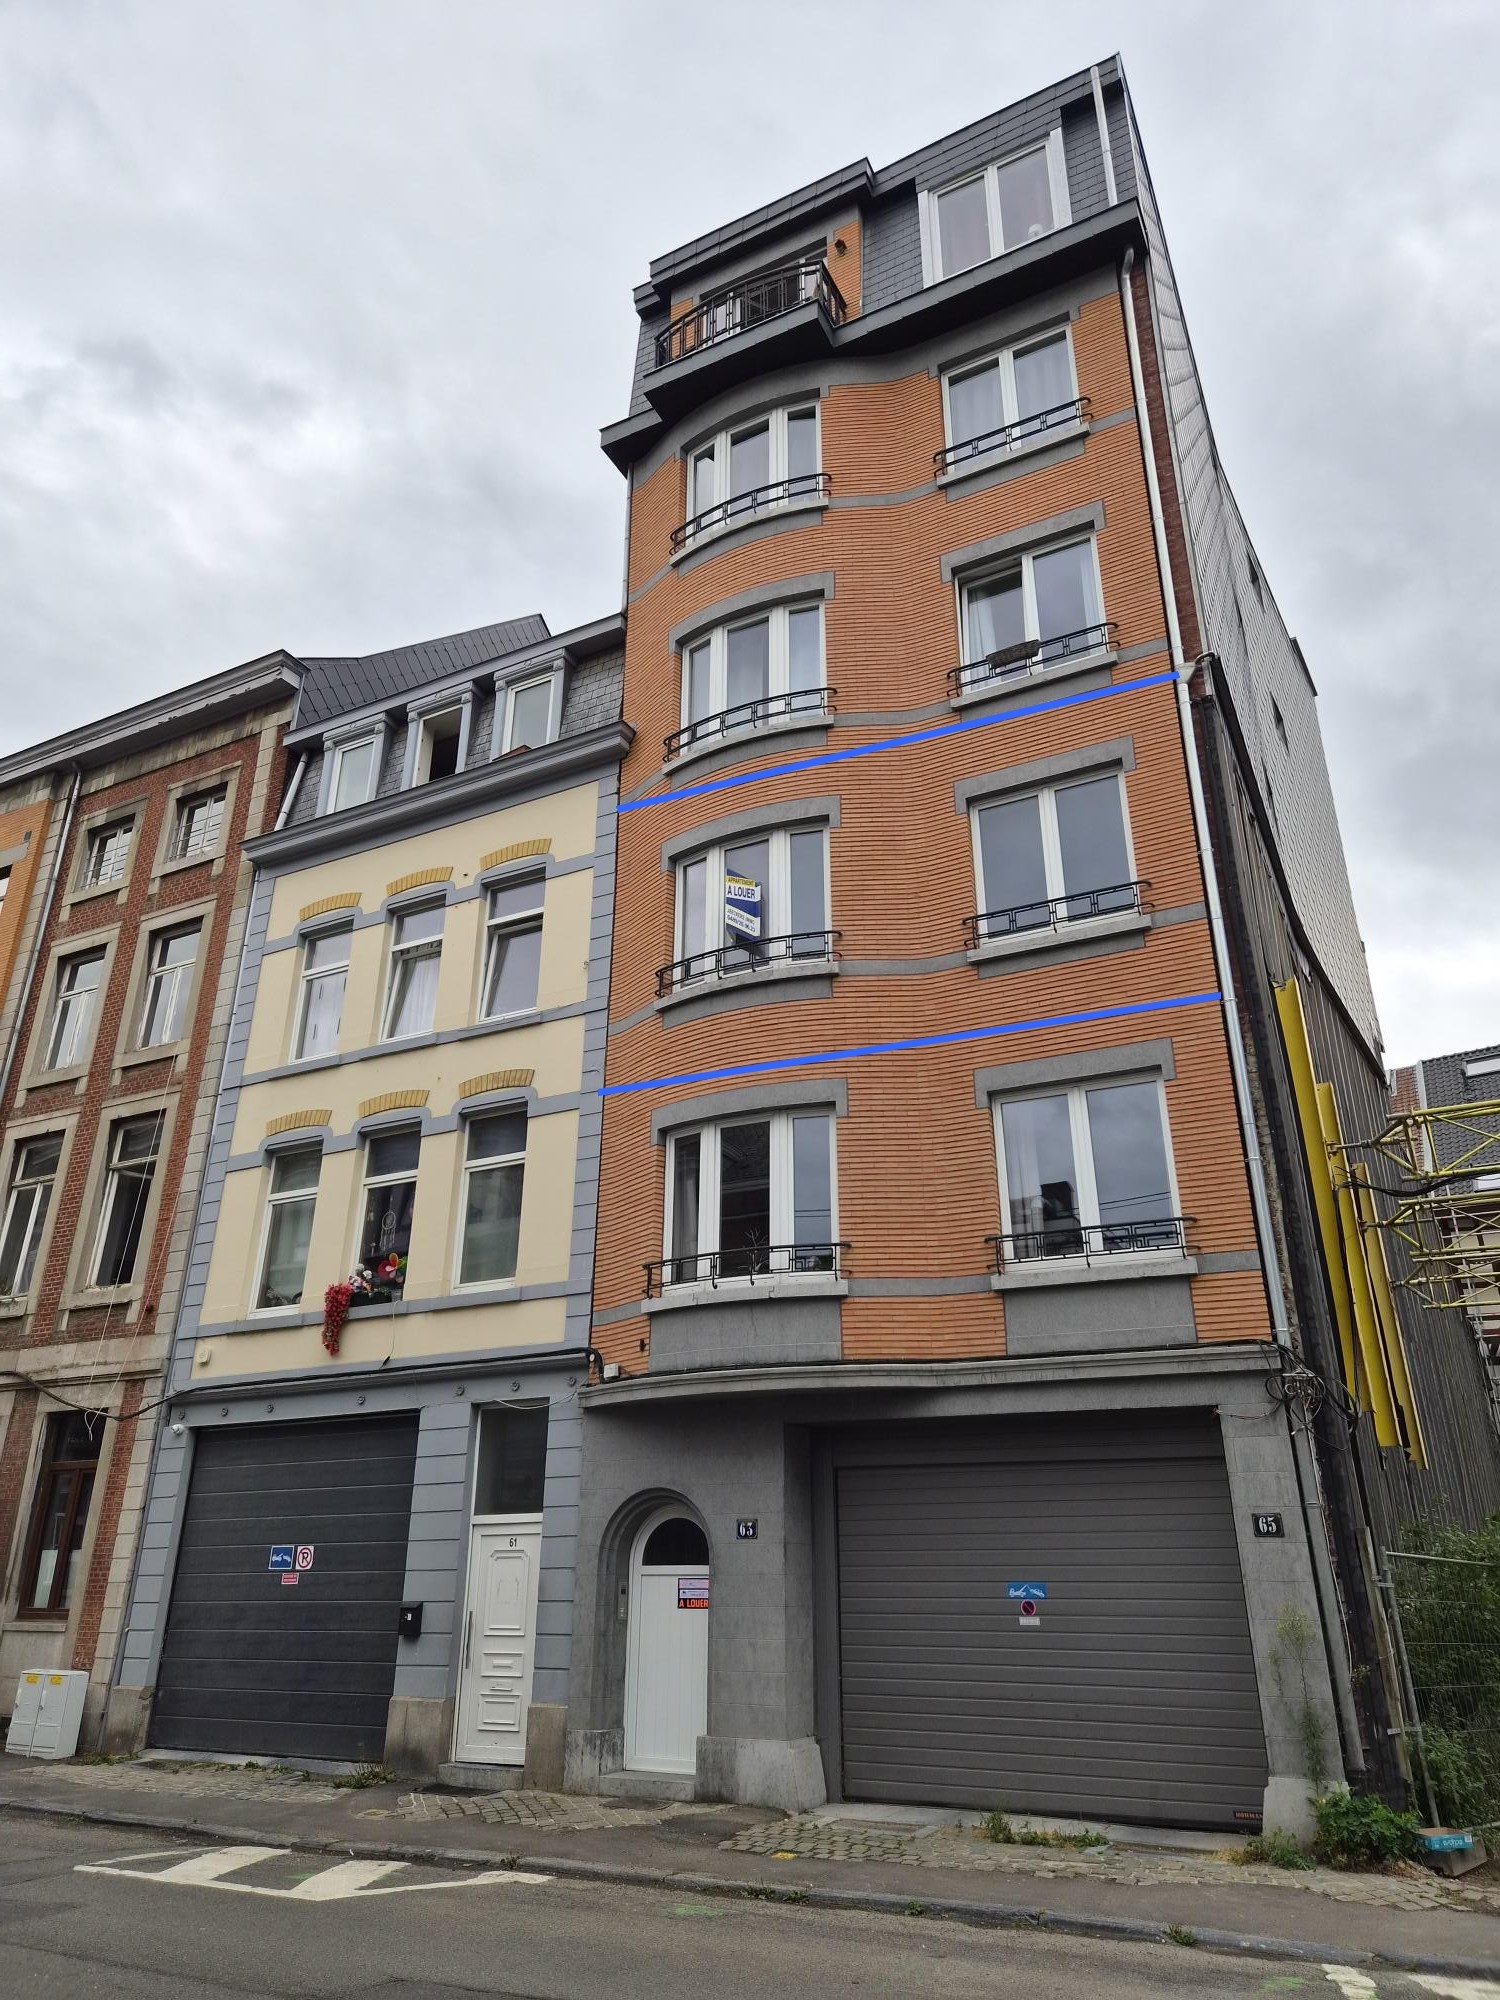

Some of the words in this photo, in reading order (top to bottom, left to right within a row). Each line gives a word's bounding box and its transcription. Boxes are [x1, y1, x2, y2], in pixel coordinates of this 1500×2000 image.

[727, 877, 755, 887] APPARTEMENT
[727, 885, 732, 896] A
[733, 886, 756, 899] LOUER
[739, 1522, 753, 1537] 63
[1258, 1516, 1277, 1533] 65
[509, 1537, 517, 1548] 61
[679, 1599, 685, 1608] A
[686, 1599, 709, 1608] LOUER
